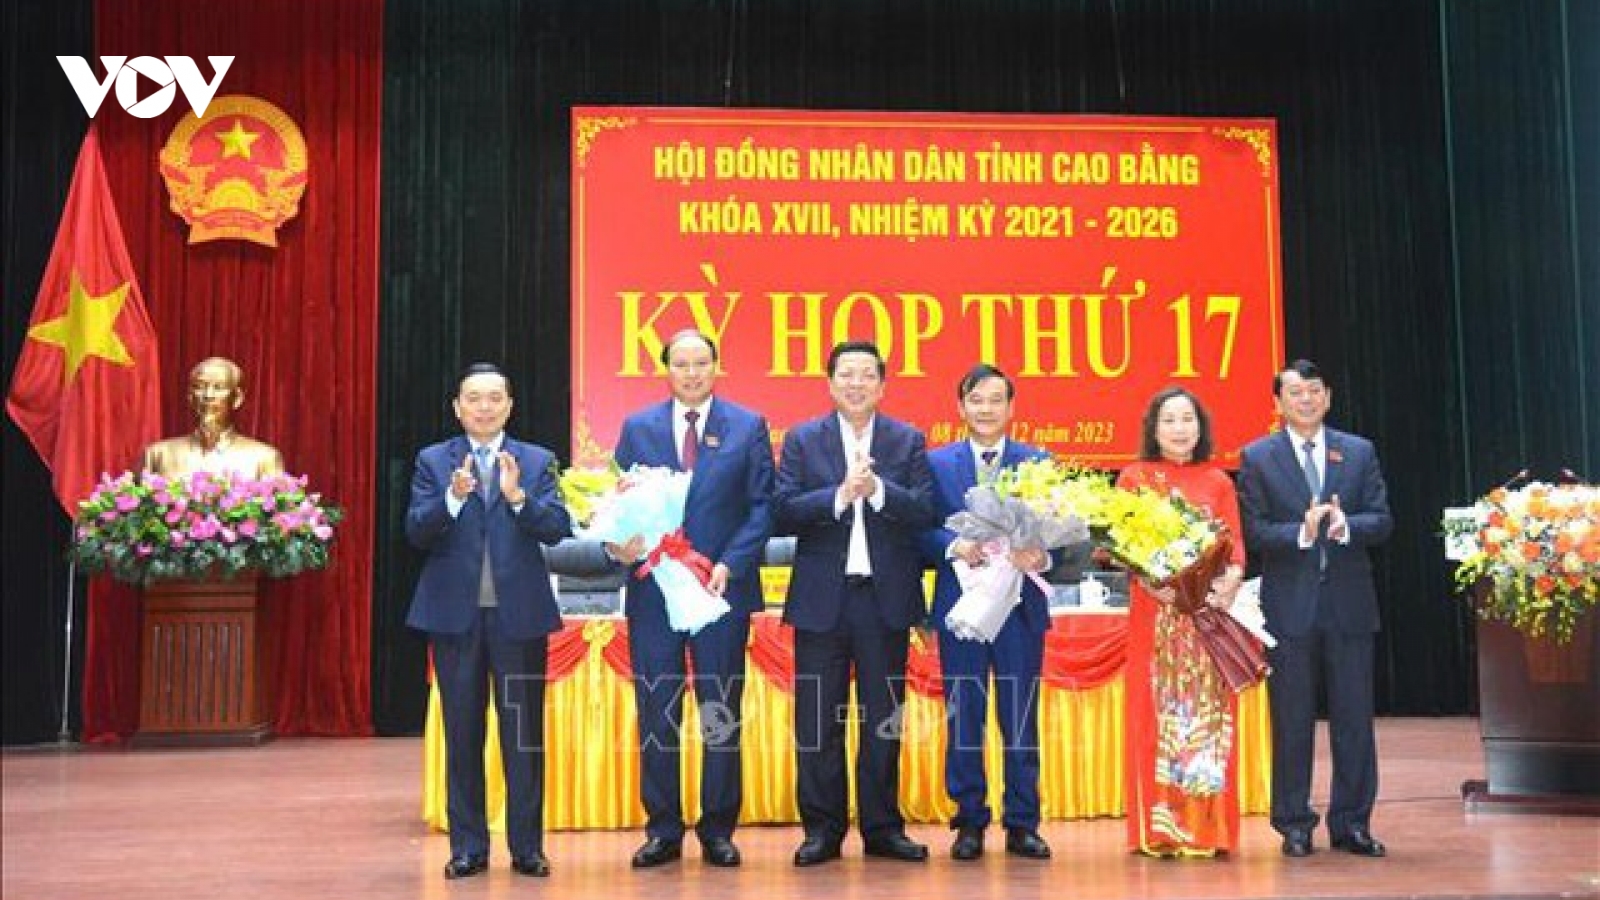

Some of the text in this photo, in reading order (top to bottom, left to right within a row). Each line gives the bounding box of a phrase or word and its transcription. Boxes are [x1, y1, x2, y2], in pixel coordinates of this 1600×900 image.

[653, 139, 706, 185] HỘI
[809, 142, 895, 182] NHÂN
[904, 144, 966, 183] DÂN
[974, 141, 1044, 184] TỈNH
[1052, 151, 1110, 185] CAO
[1118, 141, 1200, 186] BẰNG
[679, 194, 1179, 243] KHÓA XVII, NHIỆM KỲ 2021 - 2026
[615, 261, 742, 378] KỲ
[960, 265, 1146, 379] THỨ
[1166, 293, 1242, 380] 17
[929, 421, 952, 443] 08
[1010, 421, 1031, 443] 12
[1034, 424, 1071, 443] năm
[1075, 421, 1116, 444] 2023
